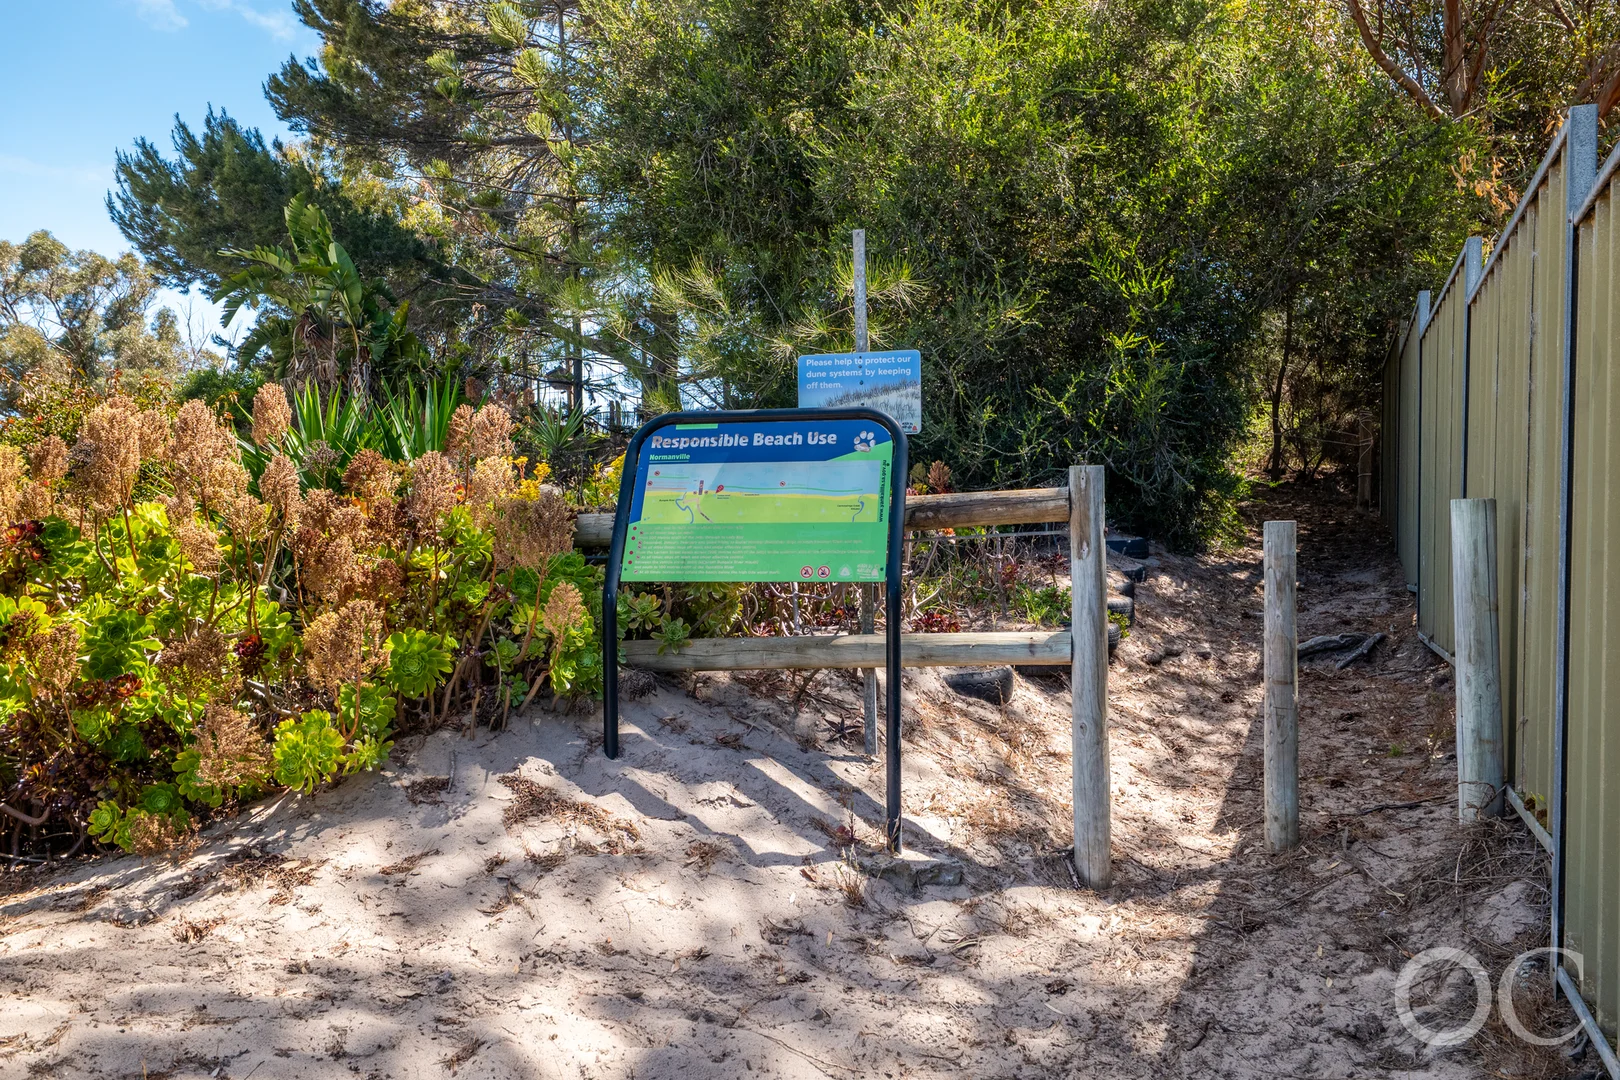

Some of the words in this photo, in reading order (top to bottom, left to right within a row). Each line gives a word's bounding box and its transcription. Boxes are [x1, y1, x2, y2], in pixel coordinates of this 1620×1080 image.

[806, 359, 833, 367] Please
[834, 358, 852, 367] help
[854, 357, 863, 366] to
[865, 356, 895, 366] protect
[829, 369, 863, 379] systems
[865, 368, 876, 377] by
[878, 367, 911, 376] keeping
[806, 381, 818, 389] off
[819, 381, 843, 389] them.
[651, 433, 748, 449] Responsible
[753, 432, 804, 446] Beach
[807, 431, 837, 445] Use
[649, 453, 690, 461] Normanville
